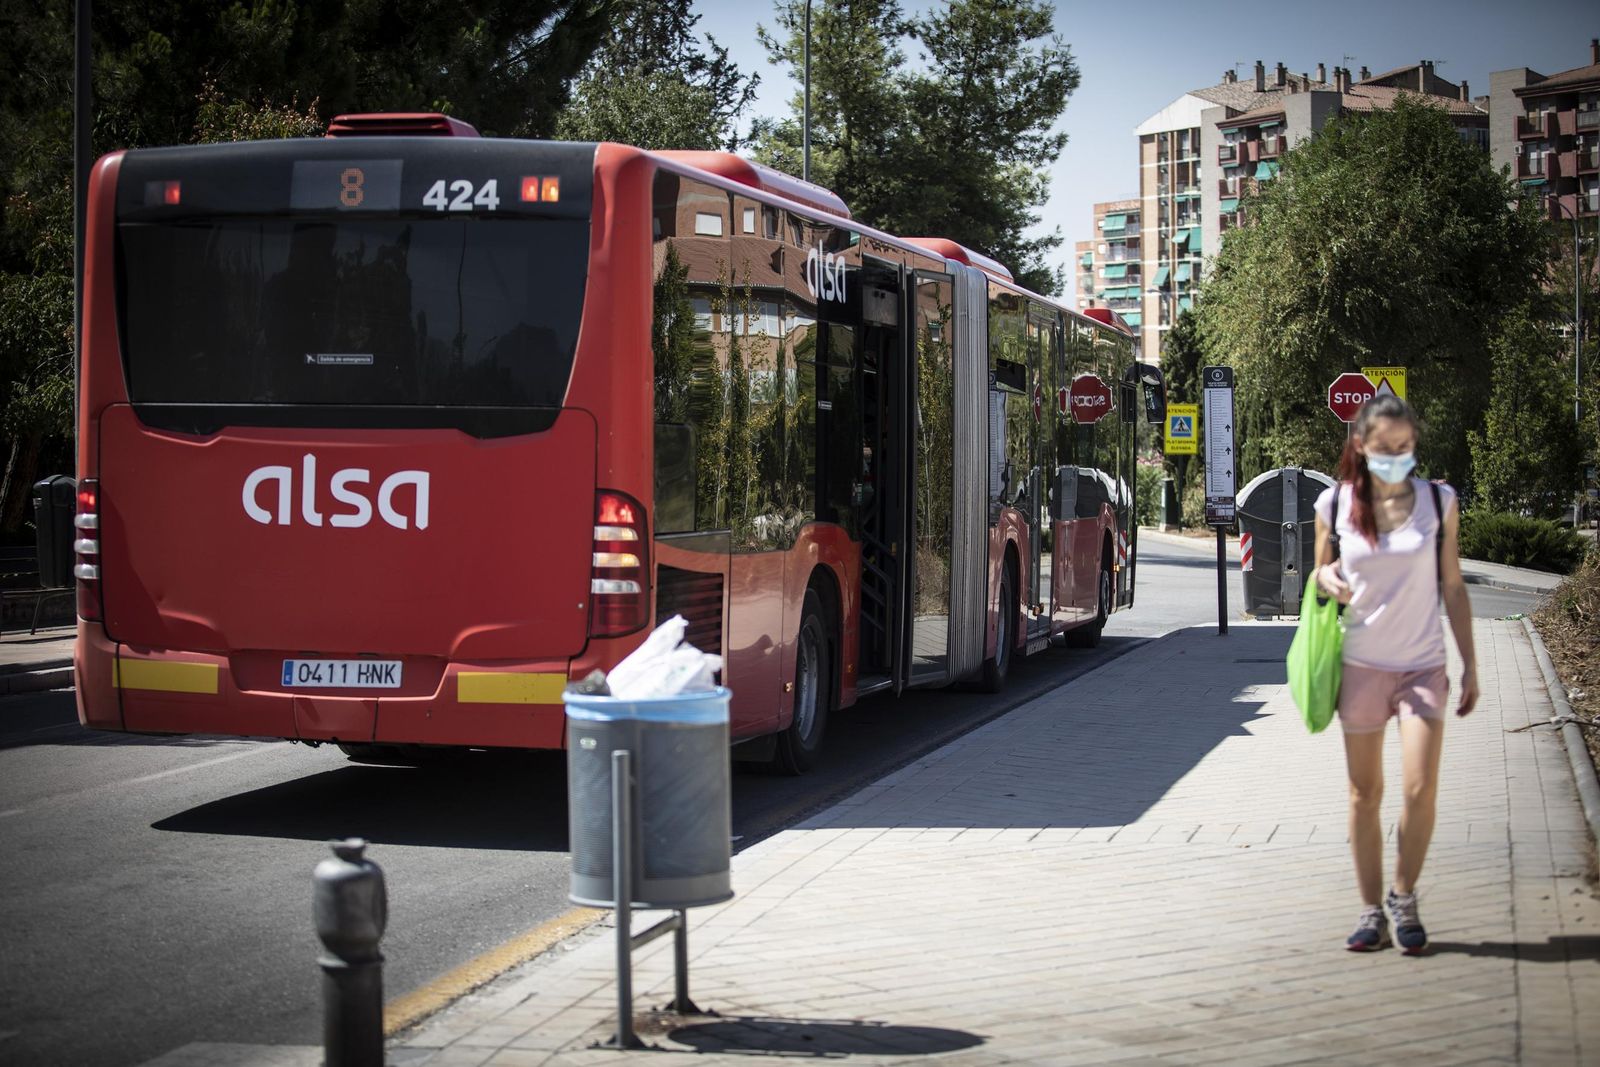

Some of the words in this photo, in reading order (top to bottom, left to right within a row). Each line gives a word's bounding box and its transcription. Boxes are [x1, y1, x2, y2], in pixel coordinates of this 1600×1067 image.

[341, 168, 364, 206] 8
[423, 179, 500, 211] 424
[807, 239, 846, 304] alsa
[1334, 392, 1372, 404] STOP
[242, 453, 430, 530] alsa
[298, 663, 347, 684] 0411
[357, 663, 396, 684] HNK
